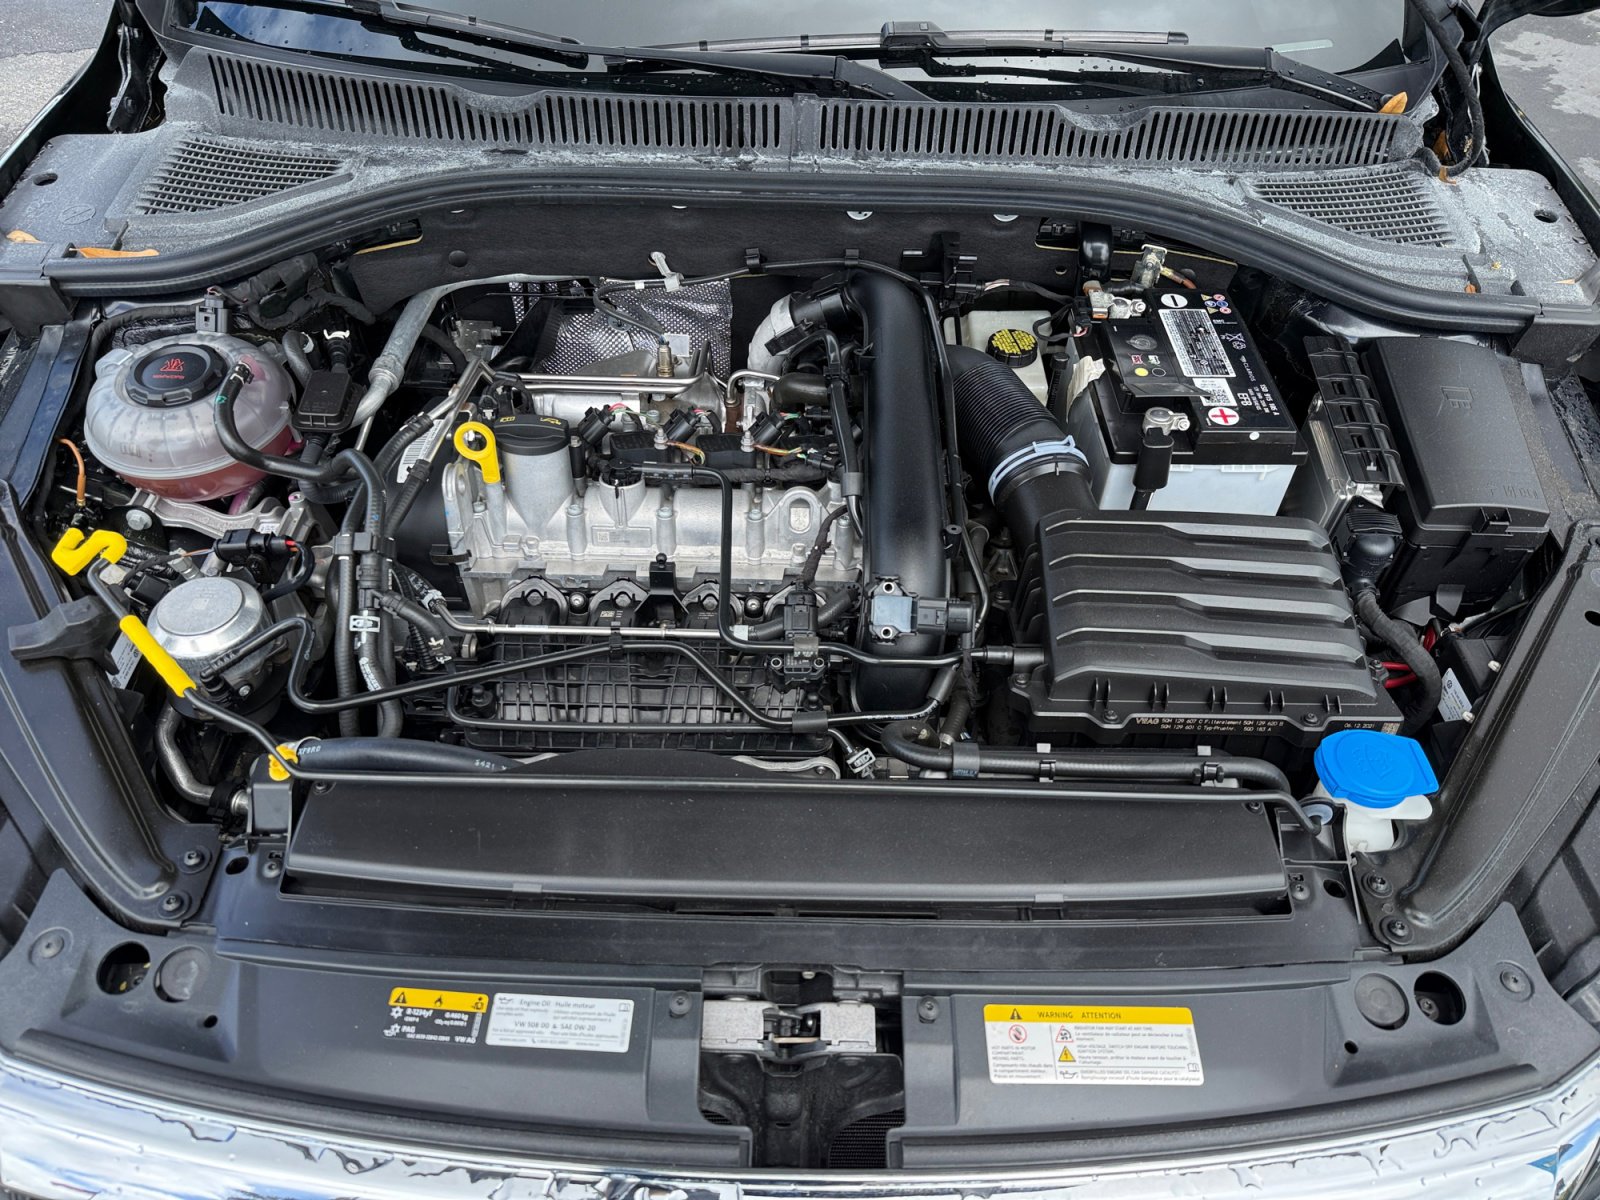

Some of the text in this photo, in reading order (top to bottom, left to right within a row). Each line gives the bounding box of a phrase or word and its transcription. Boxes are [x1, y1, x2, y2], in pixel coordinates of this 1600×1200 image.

[1237, 392, 1253, 406] EFB
[520, 999, 540, 1007] Engine
[1037, 1011, 1074, 1019] WARNING
[1081, 1011, 1122, 1019] ATTENTION
